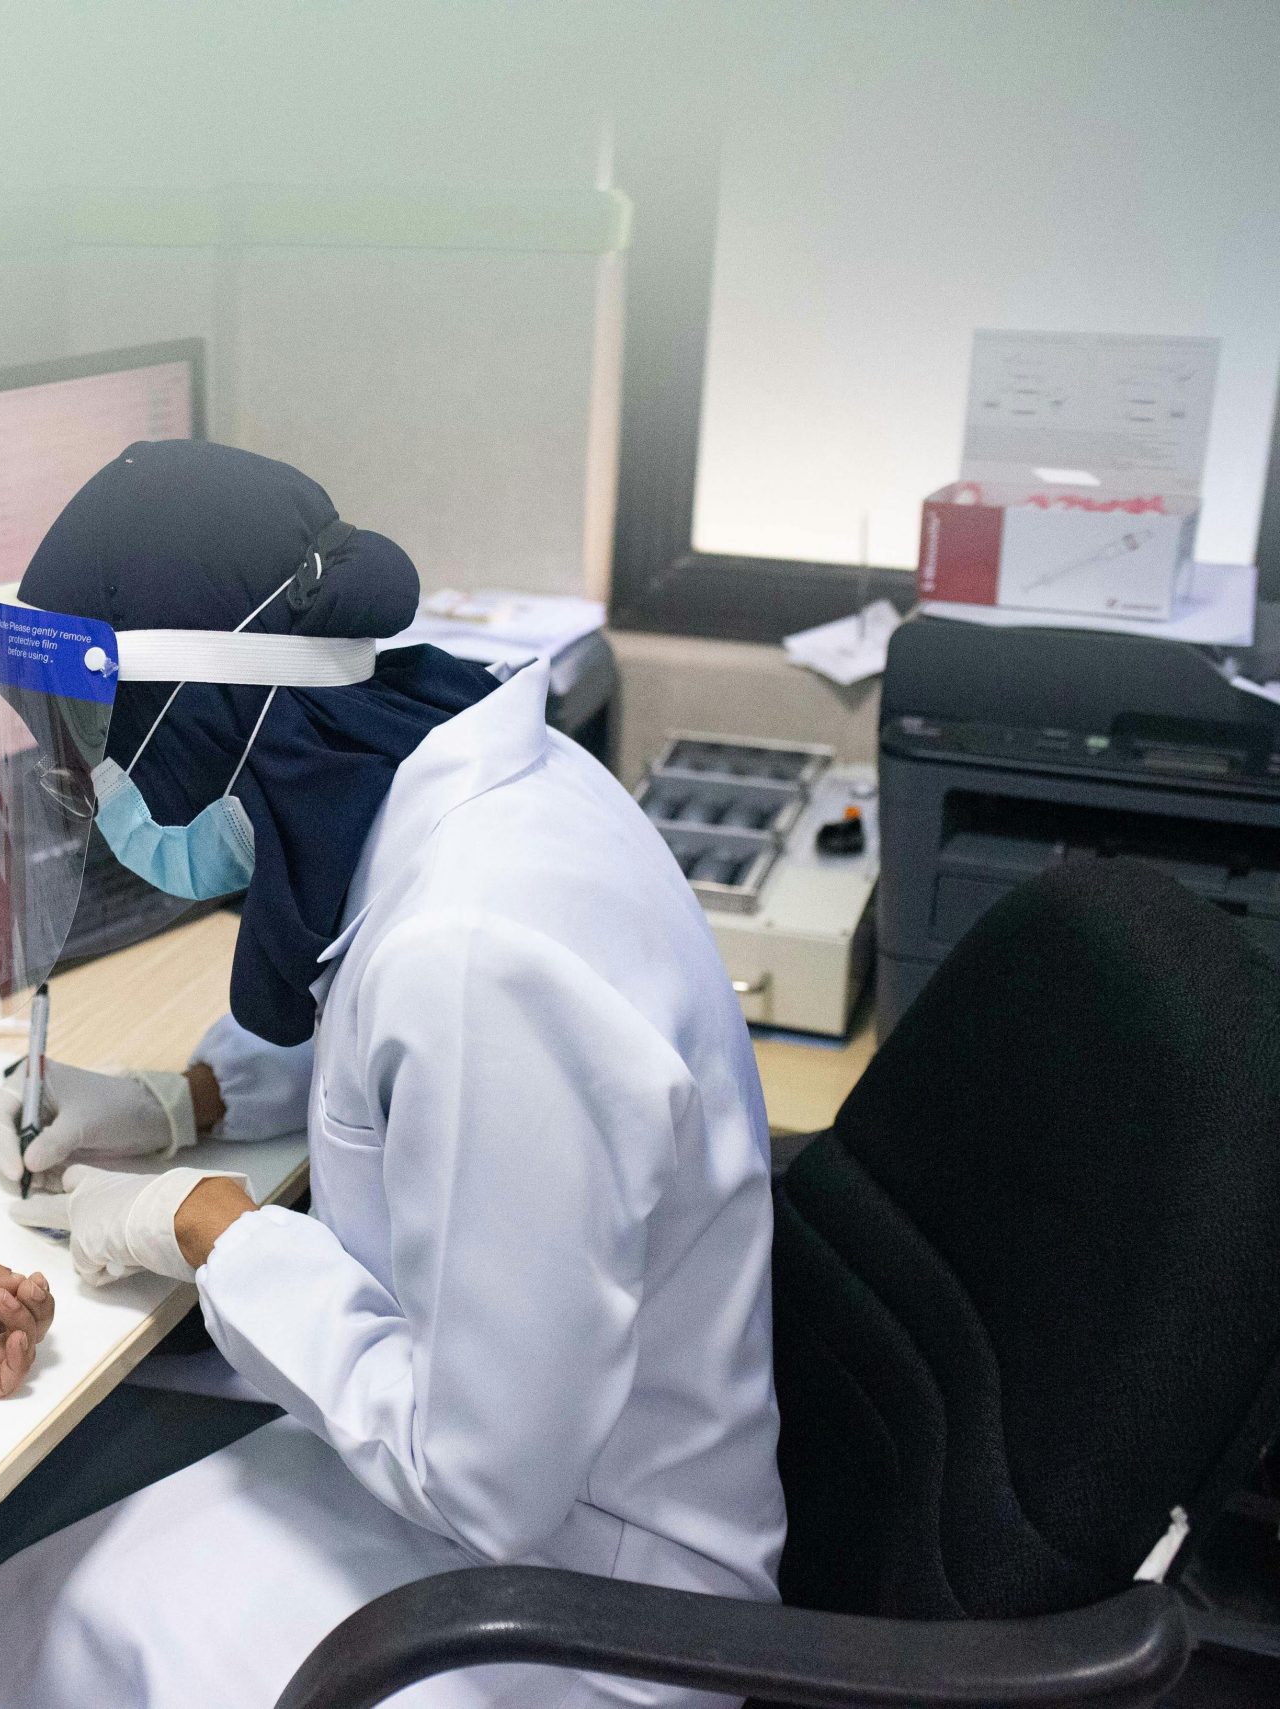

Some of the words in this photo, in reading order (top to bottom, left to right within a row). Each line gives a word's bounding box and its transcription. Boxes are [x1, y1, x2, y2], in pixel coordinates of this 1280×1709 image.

[10, 621, 30, 633] Please
[32, 626, 58, 639] gently
[59, 632, 92, 643] remove
[8, 635, 40, 647] protective
[41, 639, 58, 650] film
[8, 647, 27, 658] before
